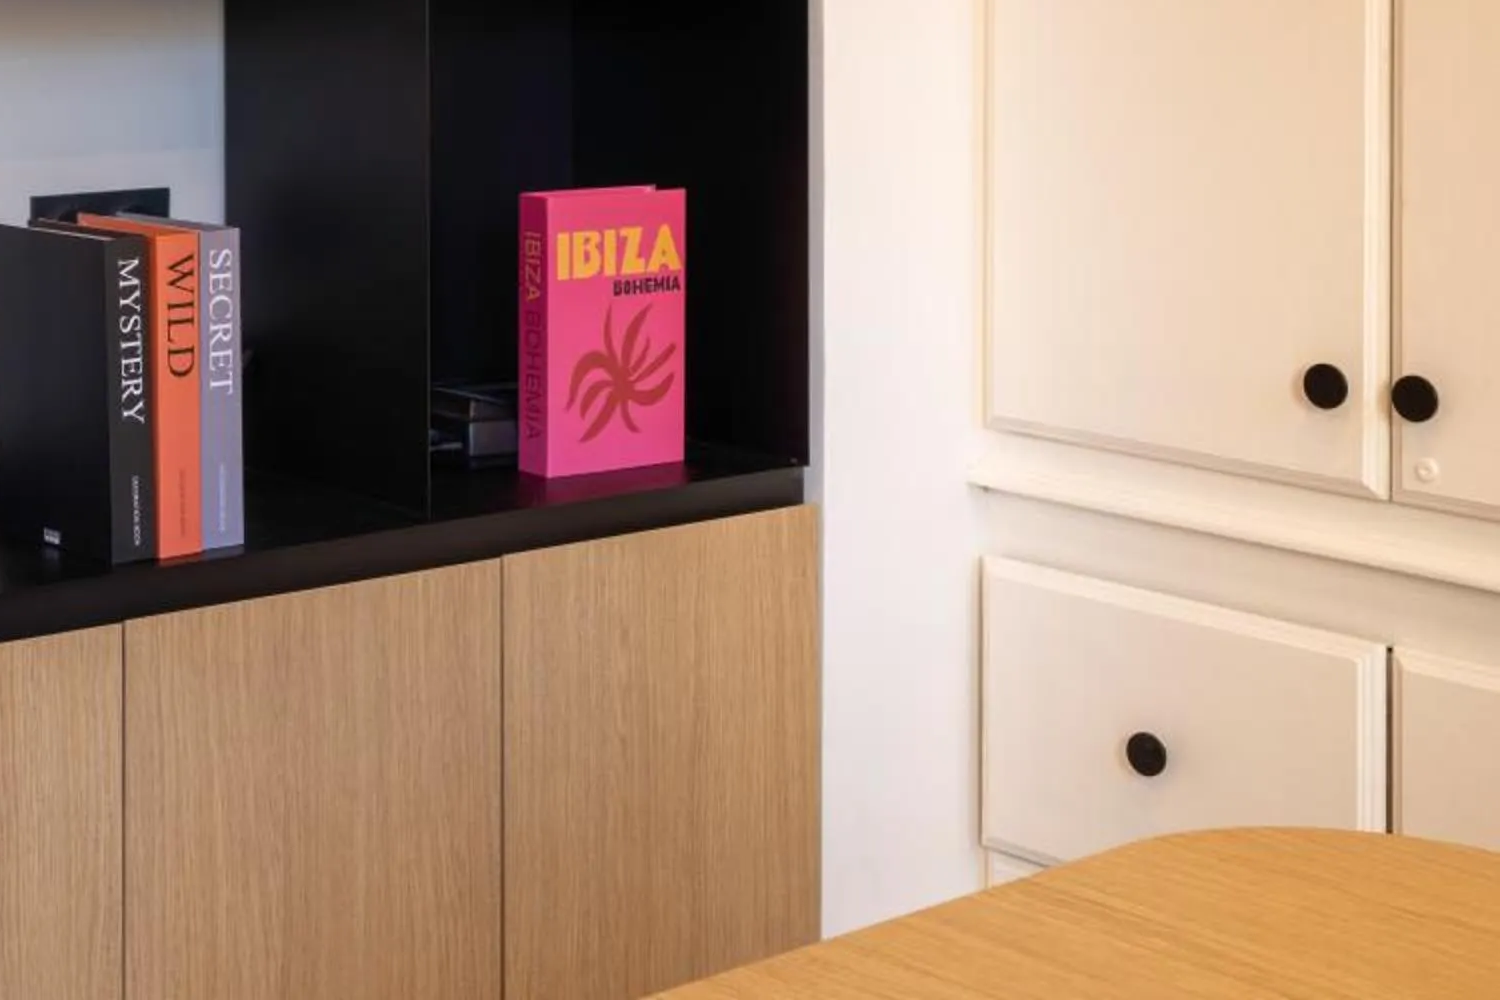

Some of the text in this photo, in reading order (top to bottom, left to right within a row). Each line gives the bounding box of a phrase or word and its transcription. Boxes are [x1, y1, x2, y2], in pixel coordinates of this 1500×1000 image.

[166, 253, 195, 378] WILD
[556, 223, 683, 280] IBIZA
[612, 275, 680, 296] BOHEMIA
[117, 257, 144, 423] MYSTERY
[208, 247, 233, 394] SECRET
[524, 231, 542, 440] IBIZA BOHEMIA
